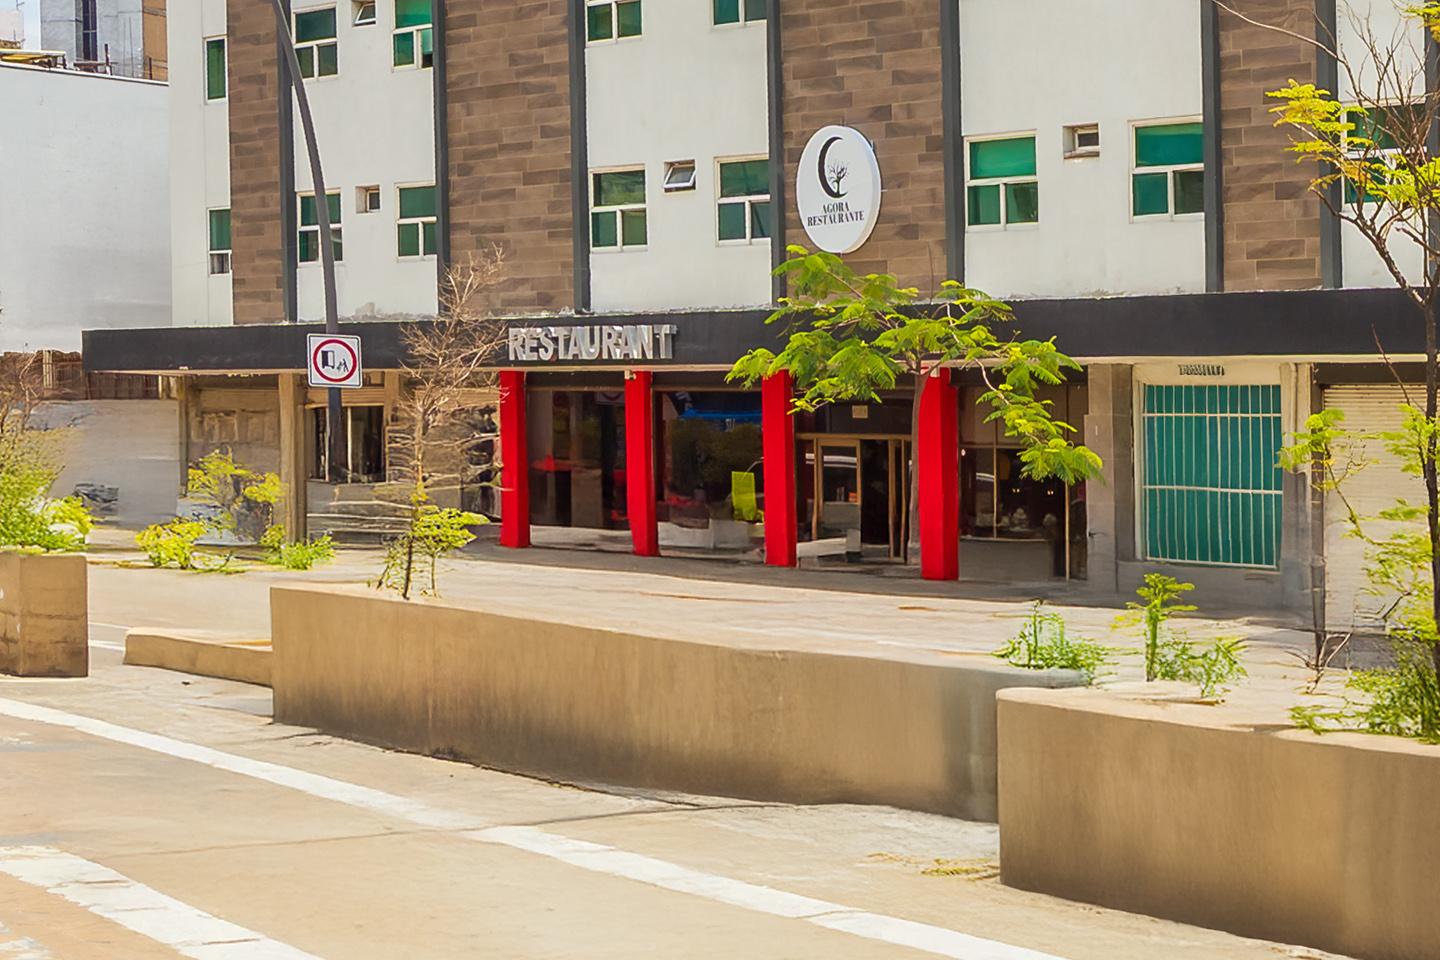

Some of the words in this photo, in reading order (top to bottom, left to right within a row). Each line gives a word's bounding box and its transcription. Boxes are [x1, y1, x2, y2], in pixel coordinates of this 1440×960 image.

[822, 201, 850, 214] AGORA
[807, 210, 865, 227] RESTAURANTE
[508, 324, 678, 360] RESTAURANT
